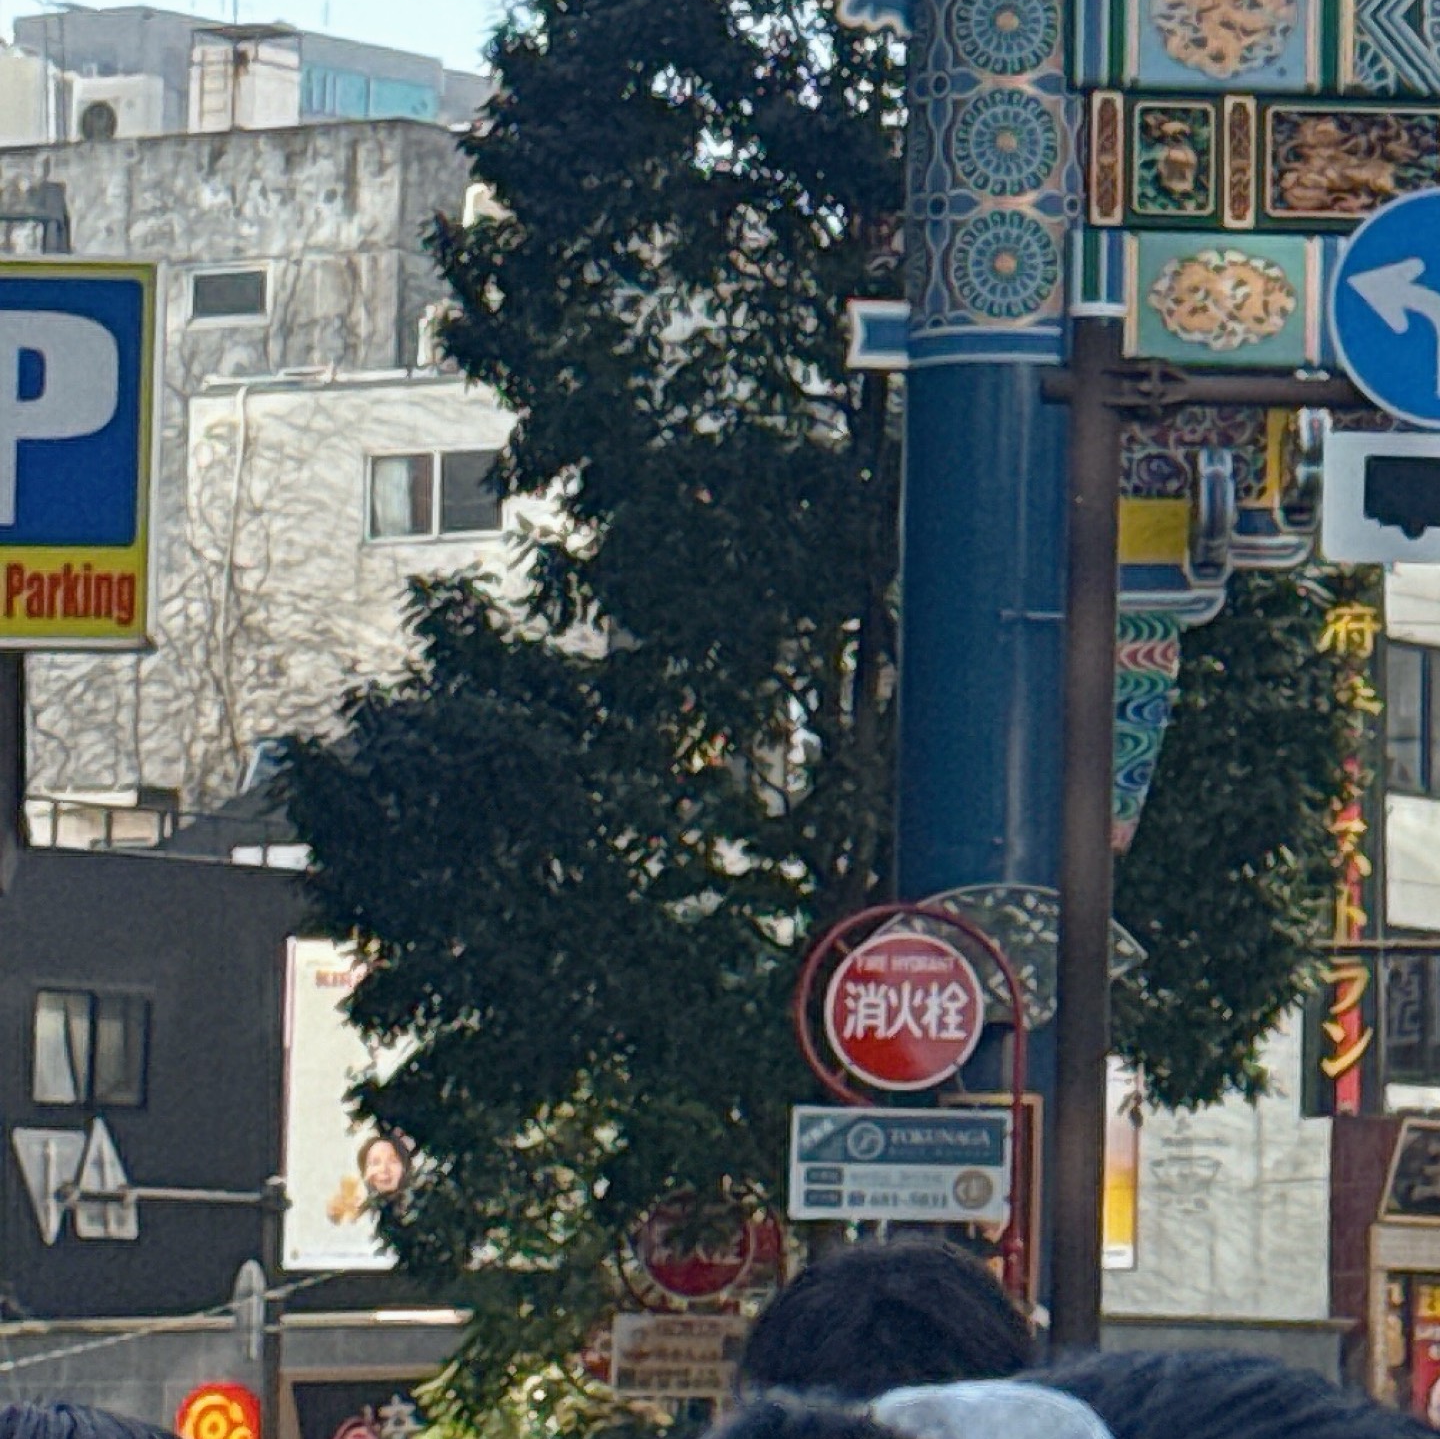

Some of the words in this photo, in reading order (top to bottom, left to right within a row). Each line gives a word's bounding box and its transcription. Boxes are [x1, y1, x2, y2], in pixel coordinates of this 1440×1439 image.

[0, 309, 119, 526] P
[5, 562, 136, 626] Parking
[842, 981, 969, 1041] 消火栓
